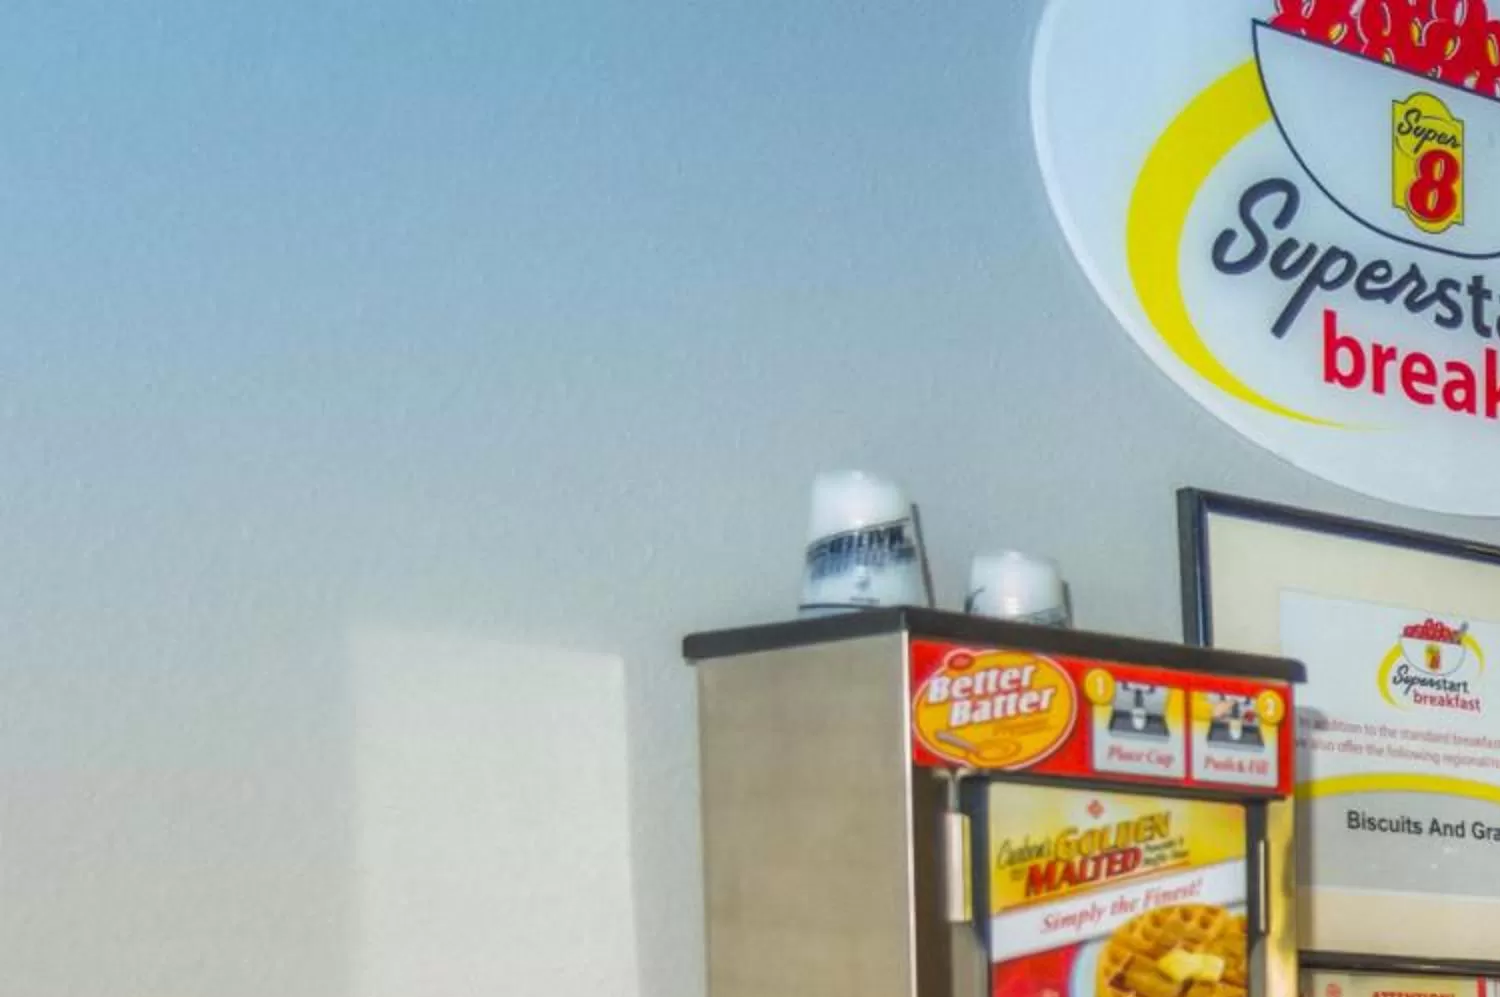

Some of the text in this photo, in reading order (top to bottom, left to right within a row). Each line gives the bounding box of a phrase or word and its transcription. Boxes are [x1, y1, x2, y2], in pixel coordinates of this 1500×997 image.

[1397, 108, 1462, 152] Super
[1405, 147, 1461, 222] 8
[926, 662, 1036, 704] Better
[1392, 664, 1469, 695] Superstart
[1413, 689, 1481, 713] breakfast
[948, 685, 1056, 729] Batter
[1056, 811, 1171, 861] GOLDEN
[1346, 809, 1424, 839] Biscuits
[1428, 816, 1467, 840] And
[1025, 847, 1143, 897] MALTED
[1041, 878, 1204, 935] Simply the Finest!
